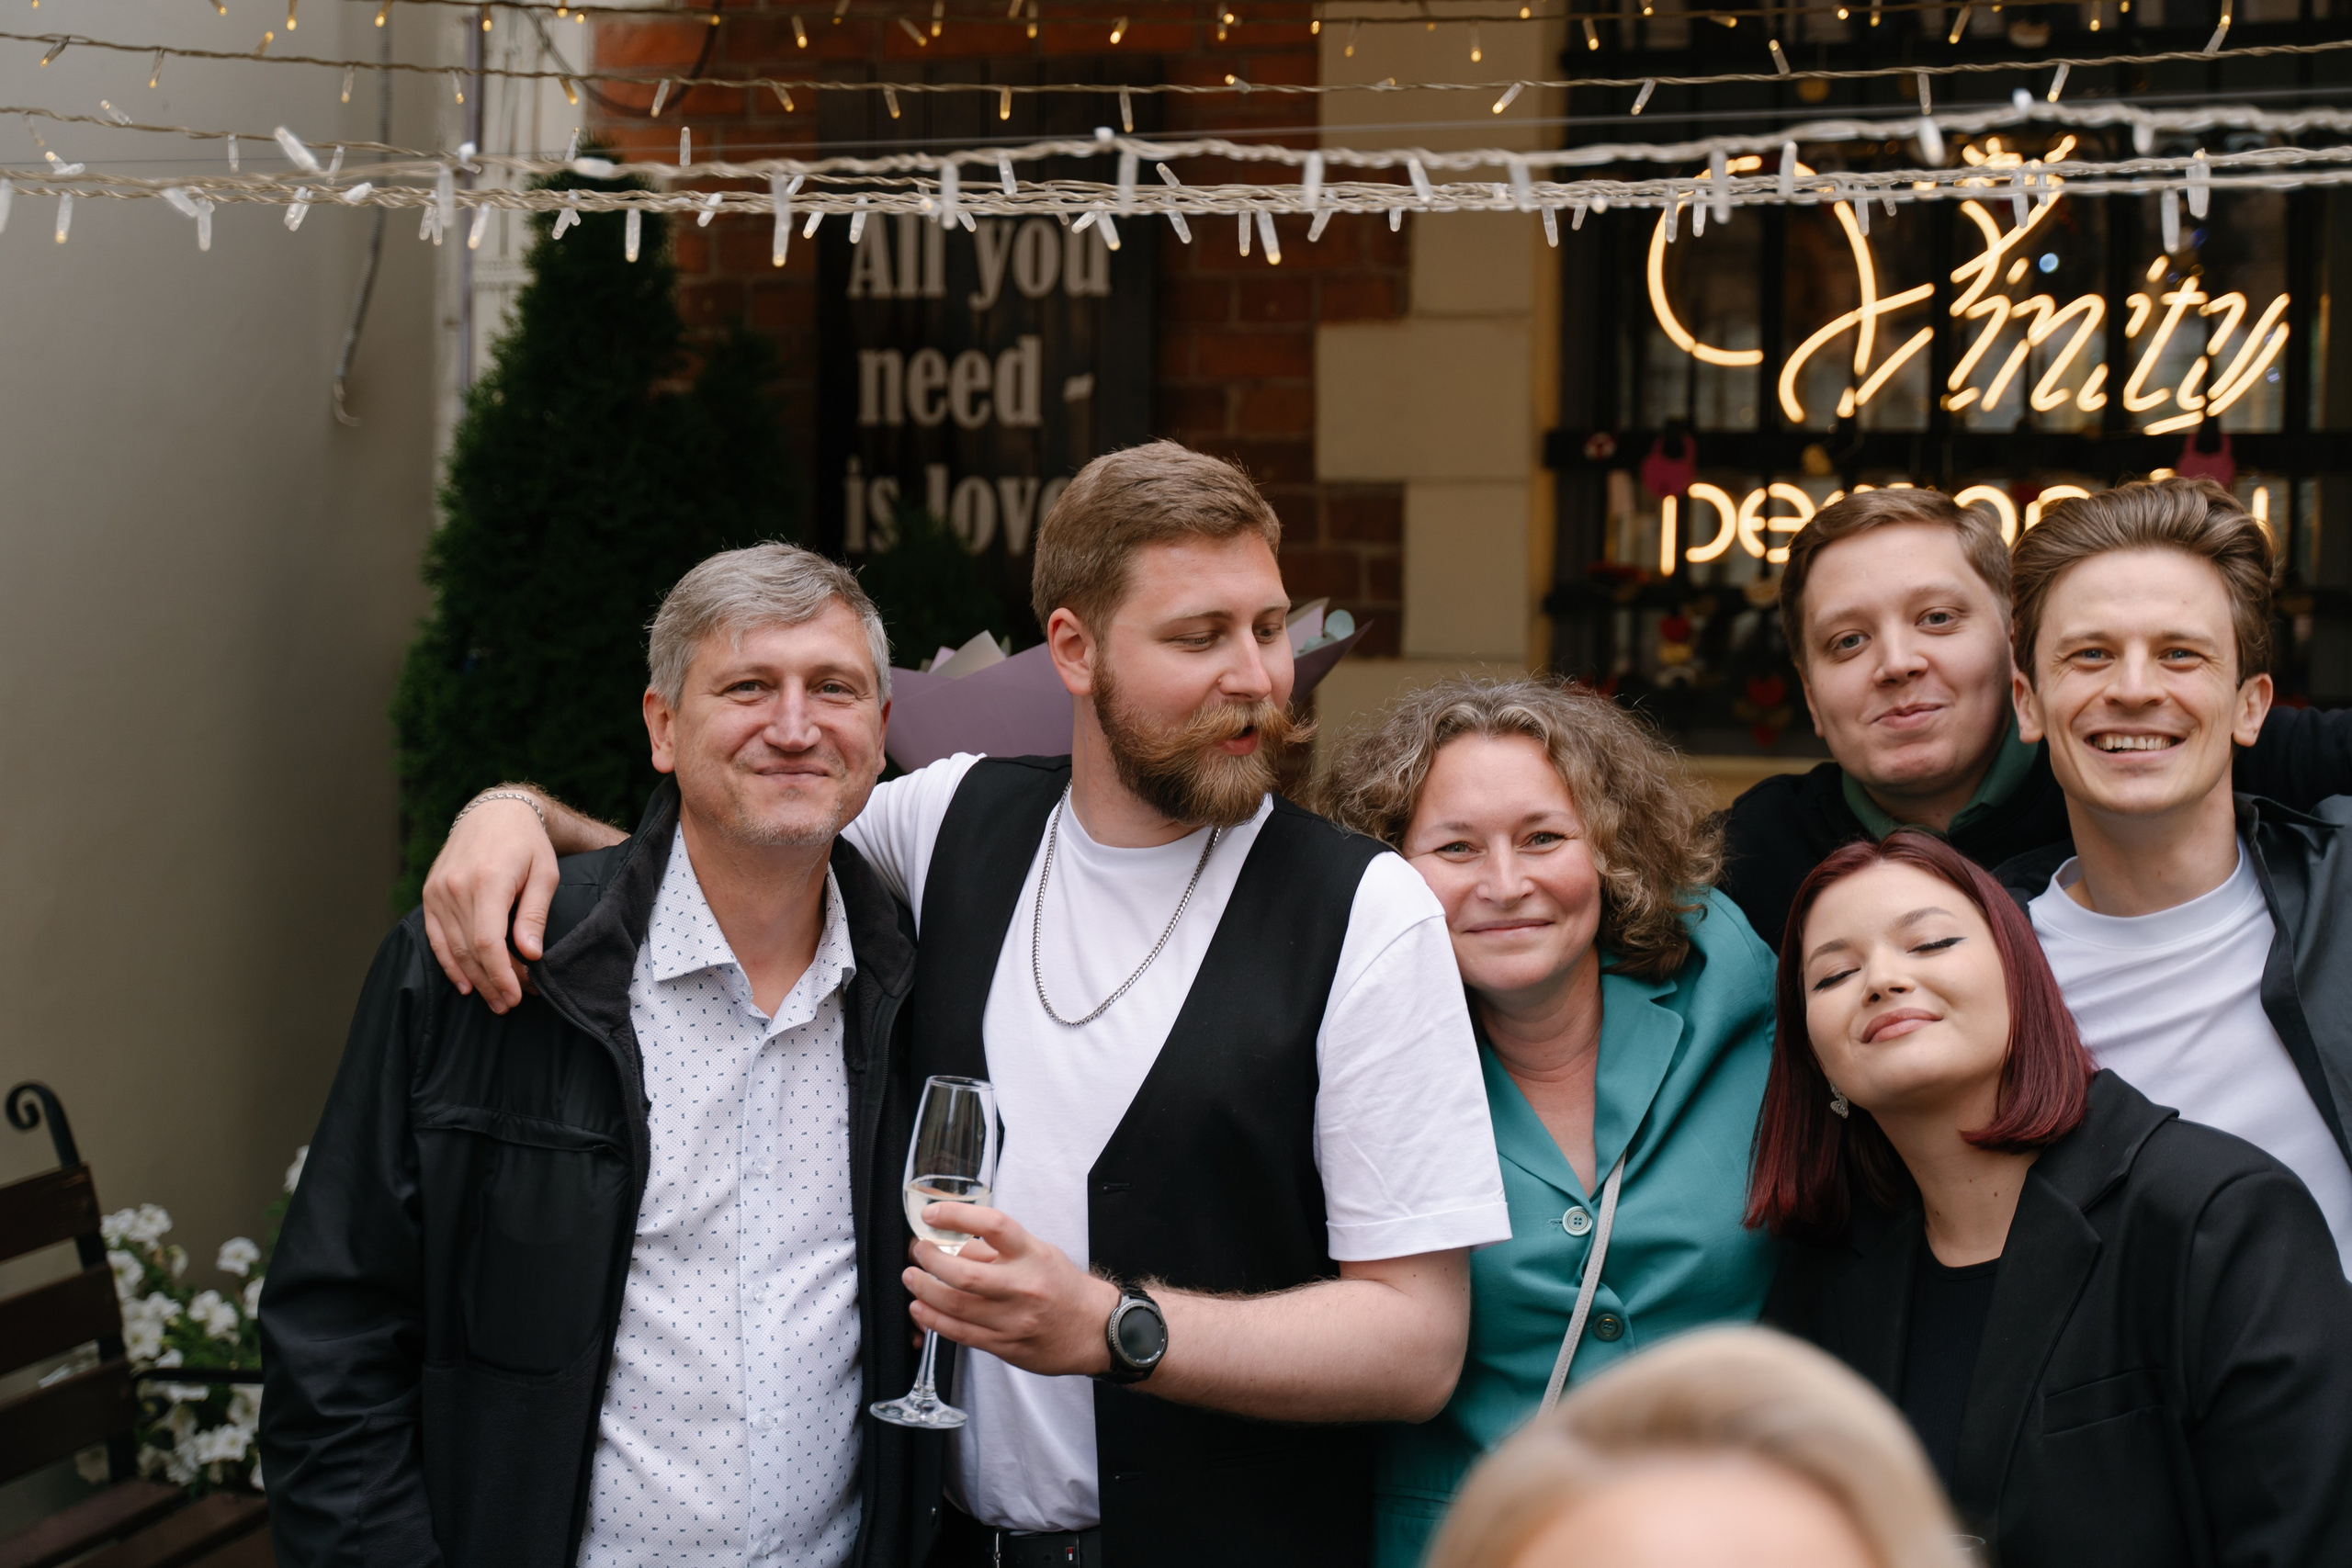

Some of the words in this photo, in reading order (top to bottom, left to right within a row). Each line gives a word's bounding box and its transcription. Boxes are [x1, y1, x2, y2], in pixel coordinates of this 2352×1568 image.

[846, 211, 947, 299] All
[967, 217, 1112, 312] you
[857, 334, 1044, 429] need
[843, 457, 903, 554] is
